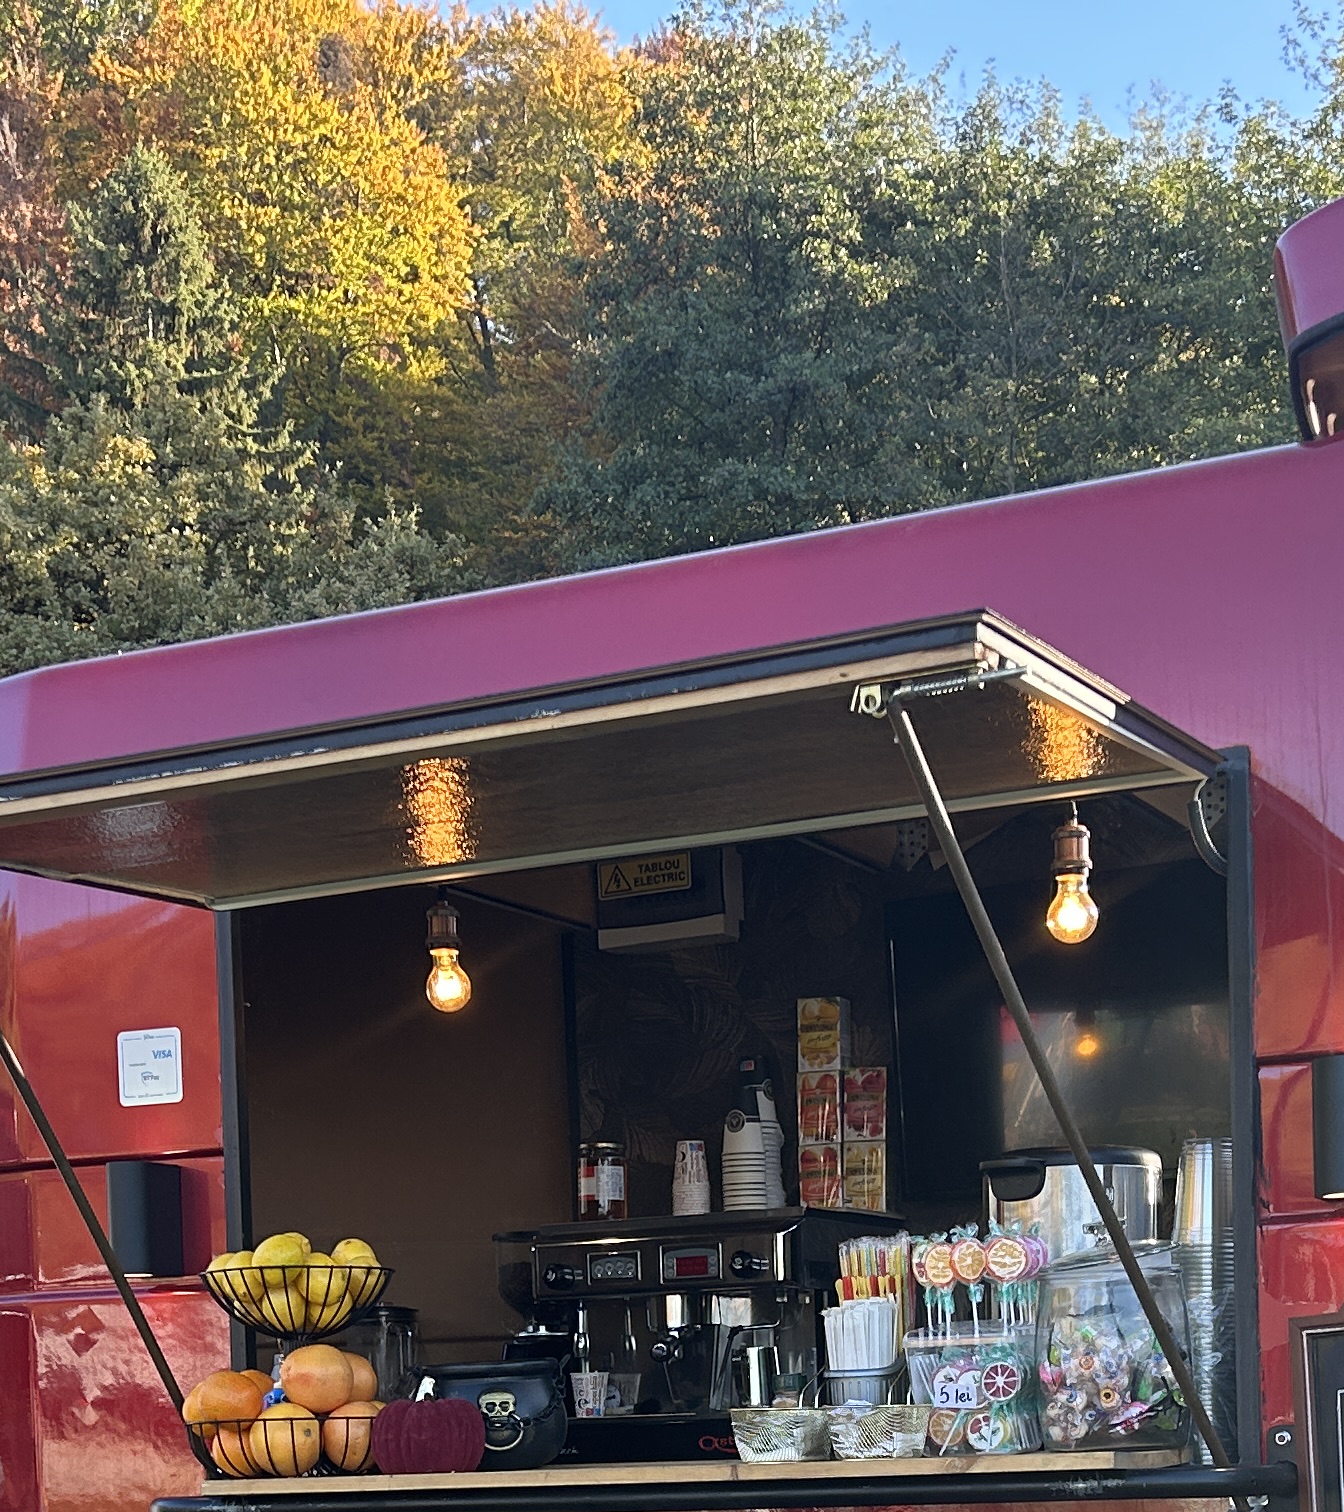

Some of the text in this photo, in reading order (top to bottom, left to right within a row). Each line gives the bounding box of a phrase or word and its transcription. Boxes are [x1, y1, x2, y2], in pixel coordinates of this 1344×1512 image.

[637, 859, 680, 874] TABLOU
[633, 871, 686, 887] ELECTRIC
[151, 1049, 173, 1060] VISA
[939, 1384, 973, 1404] 5 lei
